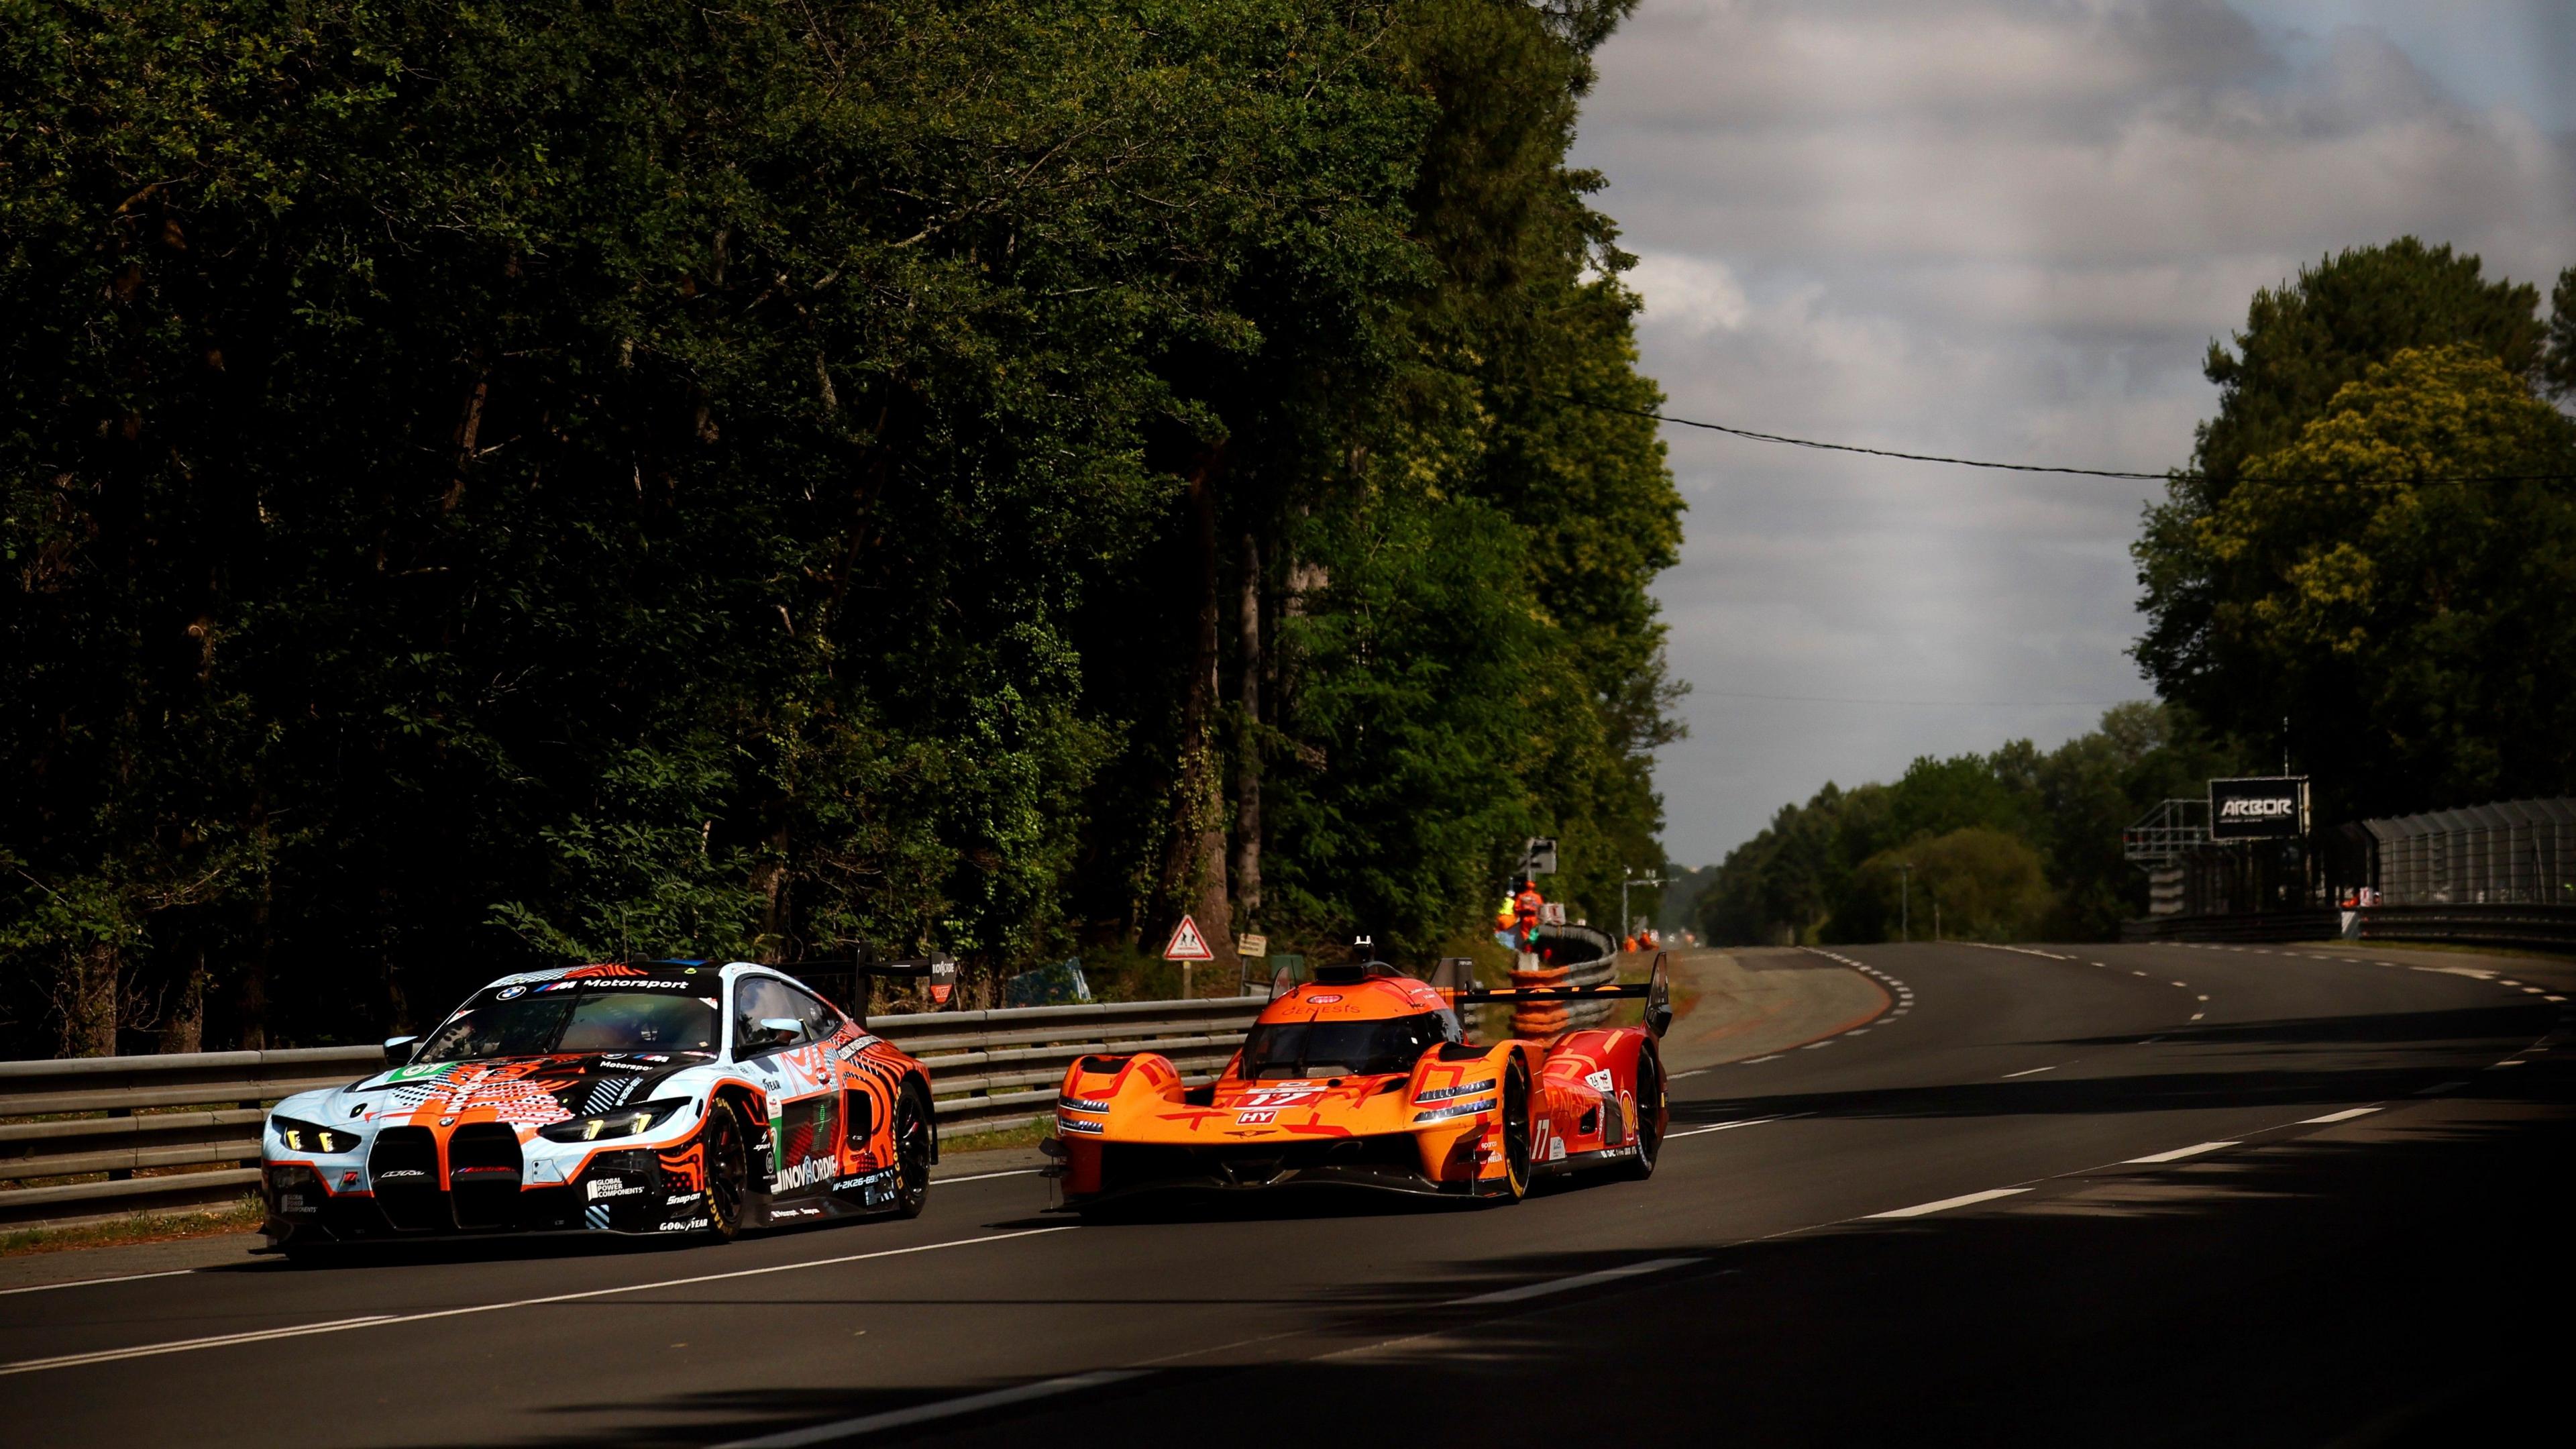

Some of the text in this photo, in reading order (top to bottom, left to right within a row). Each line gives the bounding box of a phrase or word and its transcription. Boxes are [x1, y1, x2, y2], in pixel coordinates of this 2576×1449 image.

[2220, 799, 2293, 816] ARBOR
[584, 979, 689, 989] Motorsport
[1282, 1006, 1361, 1016] GENESIS
[1248, 1092, 1312, 1106] 17
[1240, 1112, 1275, 1122] HY
[1531, 1118, 1550, 1159] 17
[597, 1177, 623, 1185] GLOBAL
[598, 1183, 623, 1192] POWER
[598, 1186, 644, 1197] COMPONENTS
[666, 1192, 701, 1205] Snap-on
[659, 1218, 708, 1232] GOODYEAR
